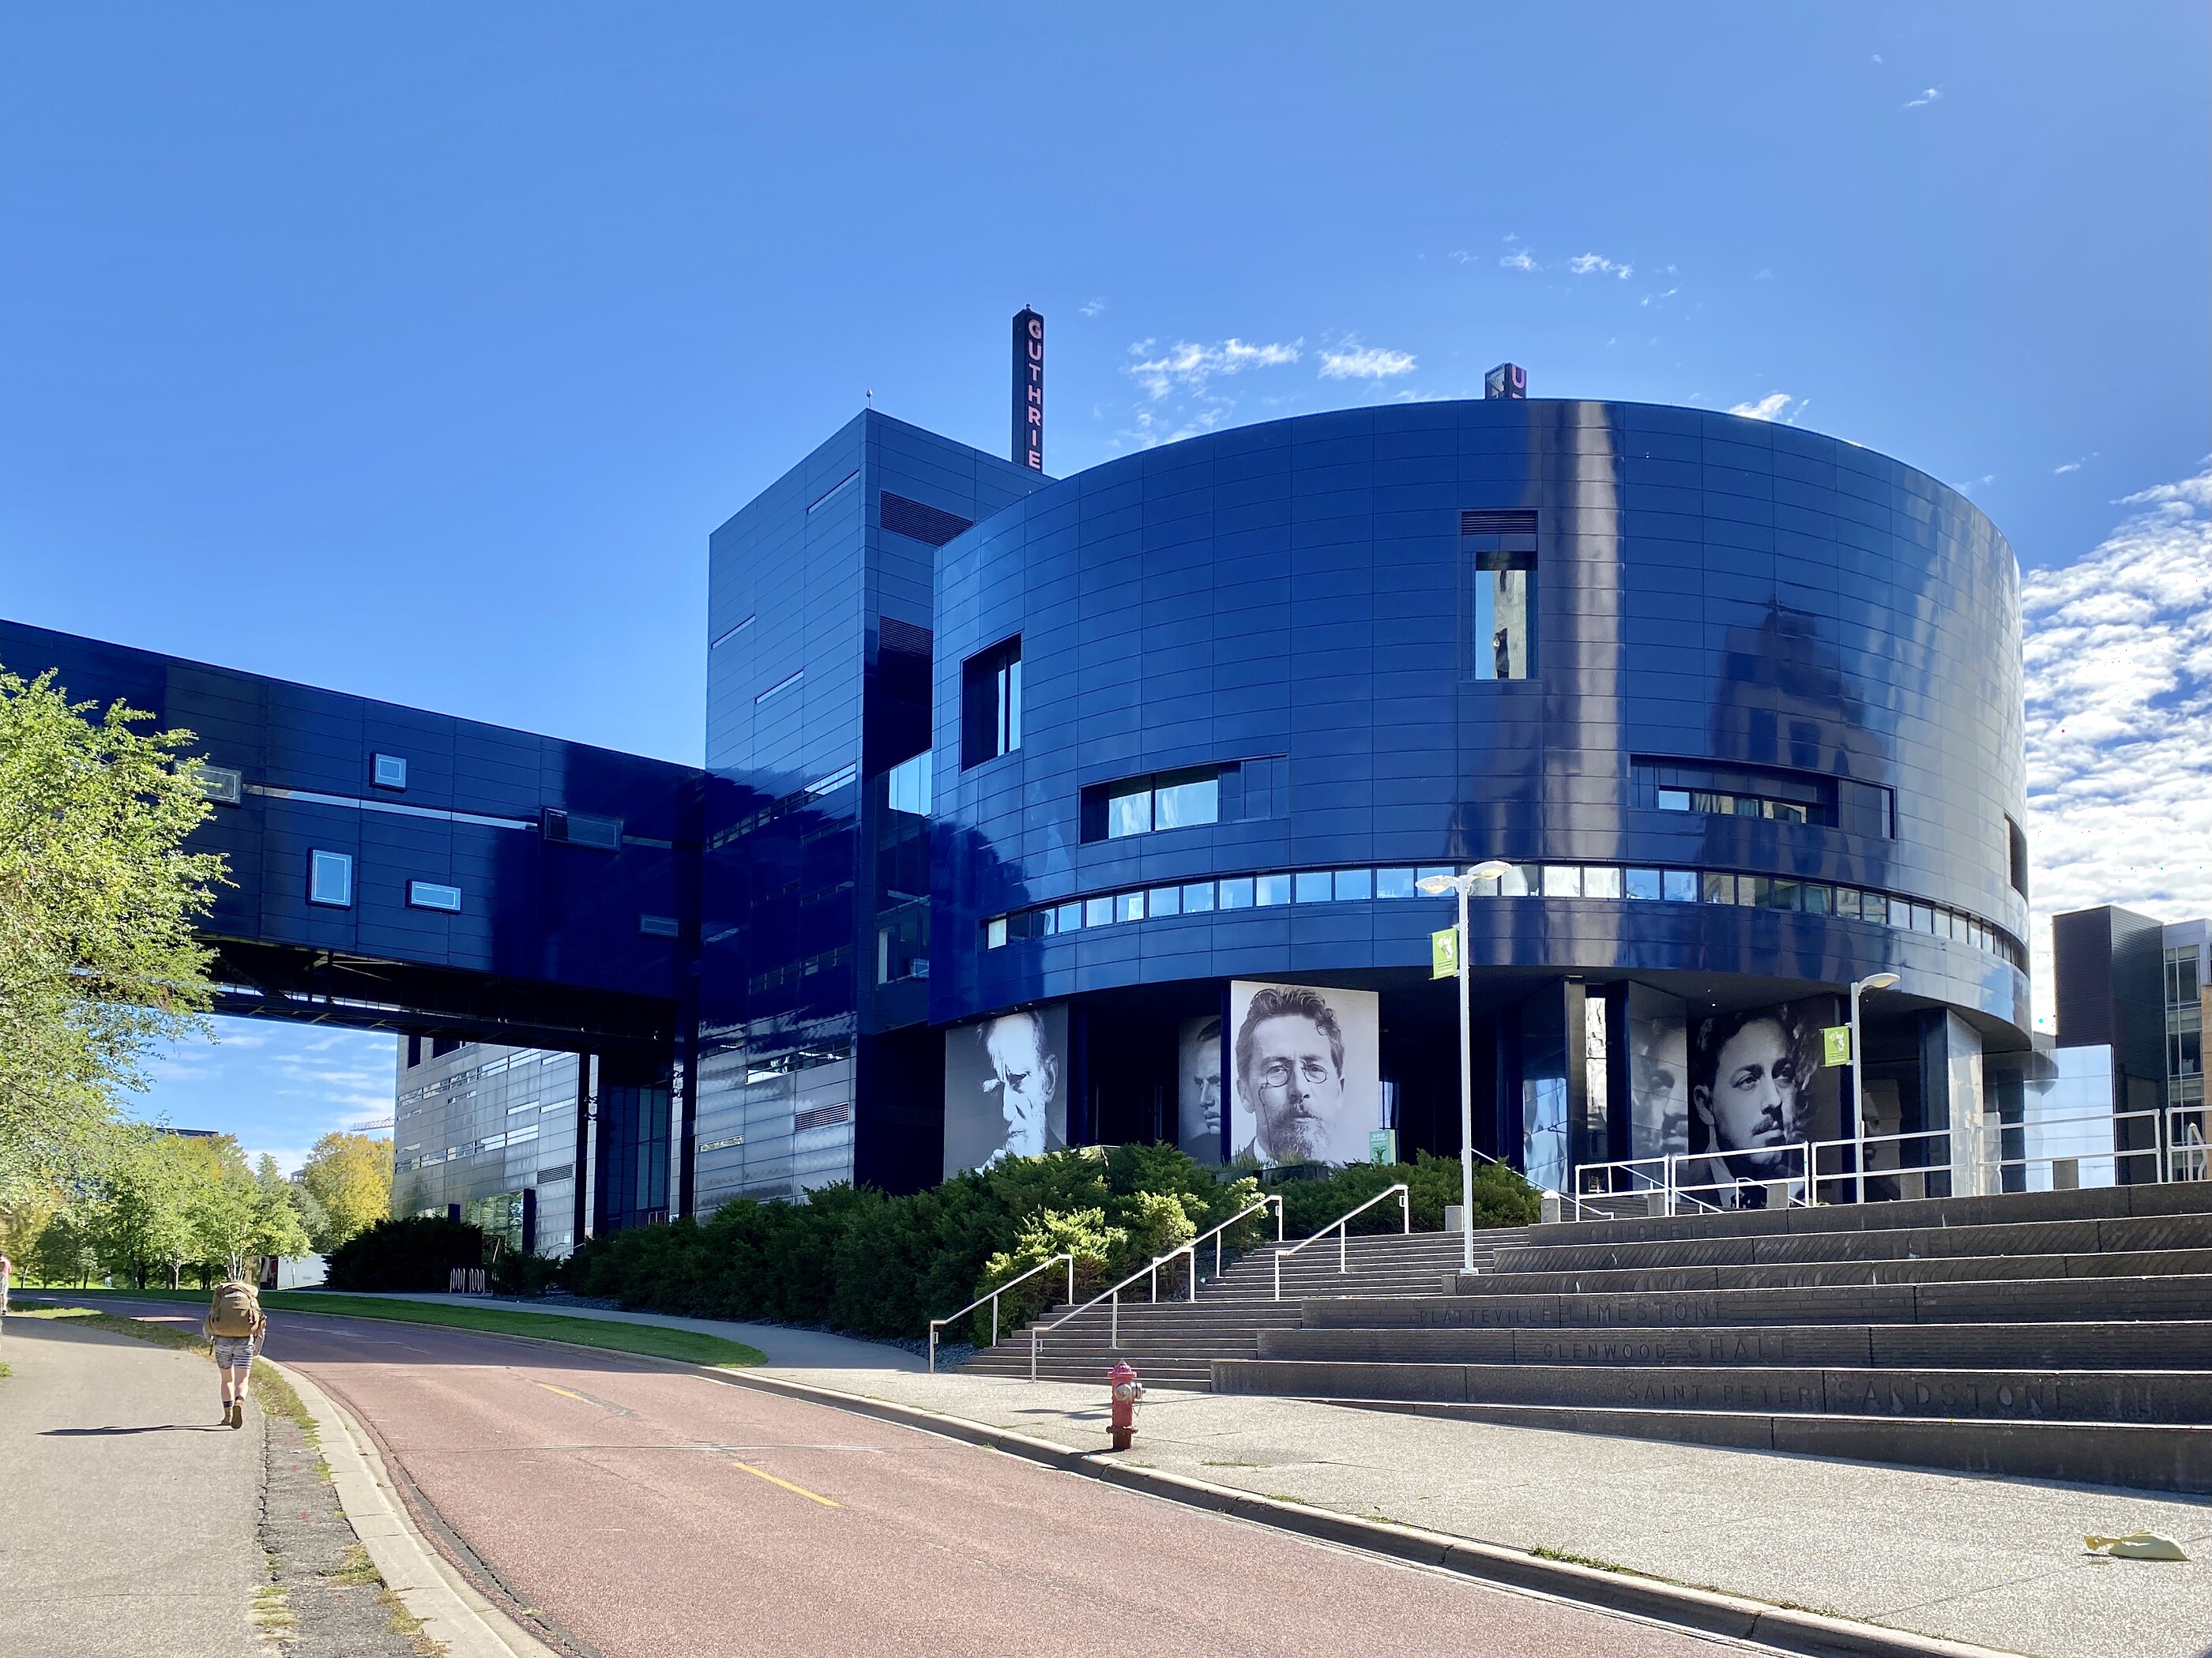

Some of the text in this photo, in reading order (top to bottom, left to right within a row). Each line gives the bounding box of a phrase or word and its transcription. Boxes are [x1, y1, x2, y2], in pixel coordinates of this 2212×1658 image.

[1029, 319, 1041, 469] GUTHRIE
[1420, 1301, 1728, 1325] PLATTEVILLE LIMESTONE
[1544, 1337, 1795, 1359] GLENWOOD SHALE
[1627, 1381, 2075, 1411] SAINT PETER SANDSTONE
